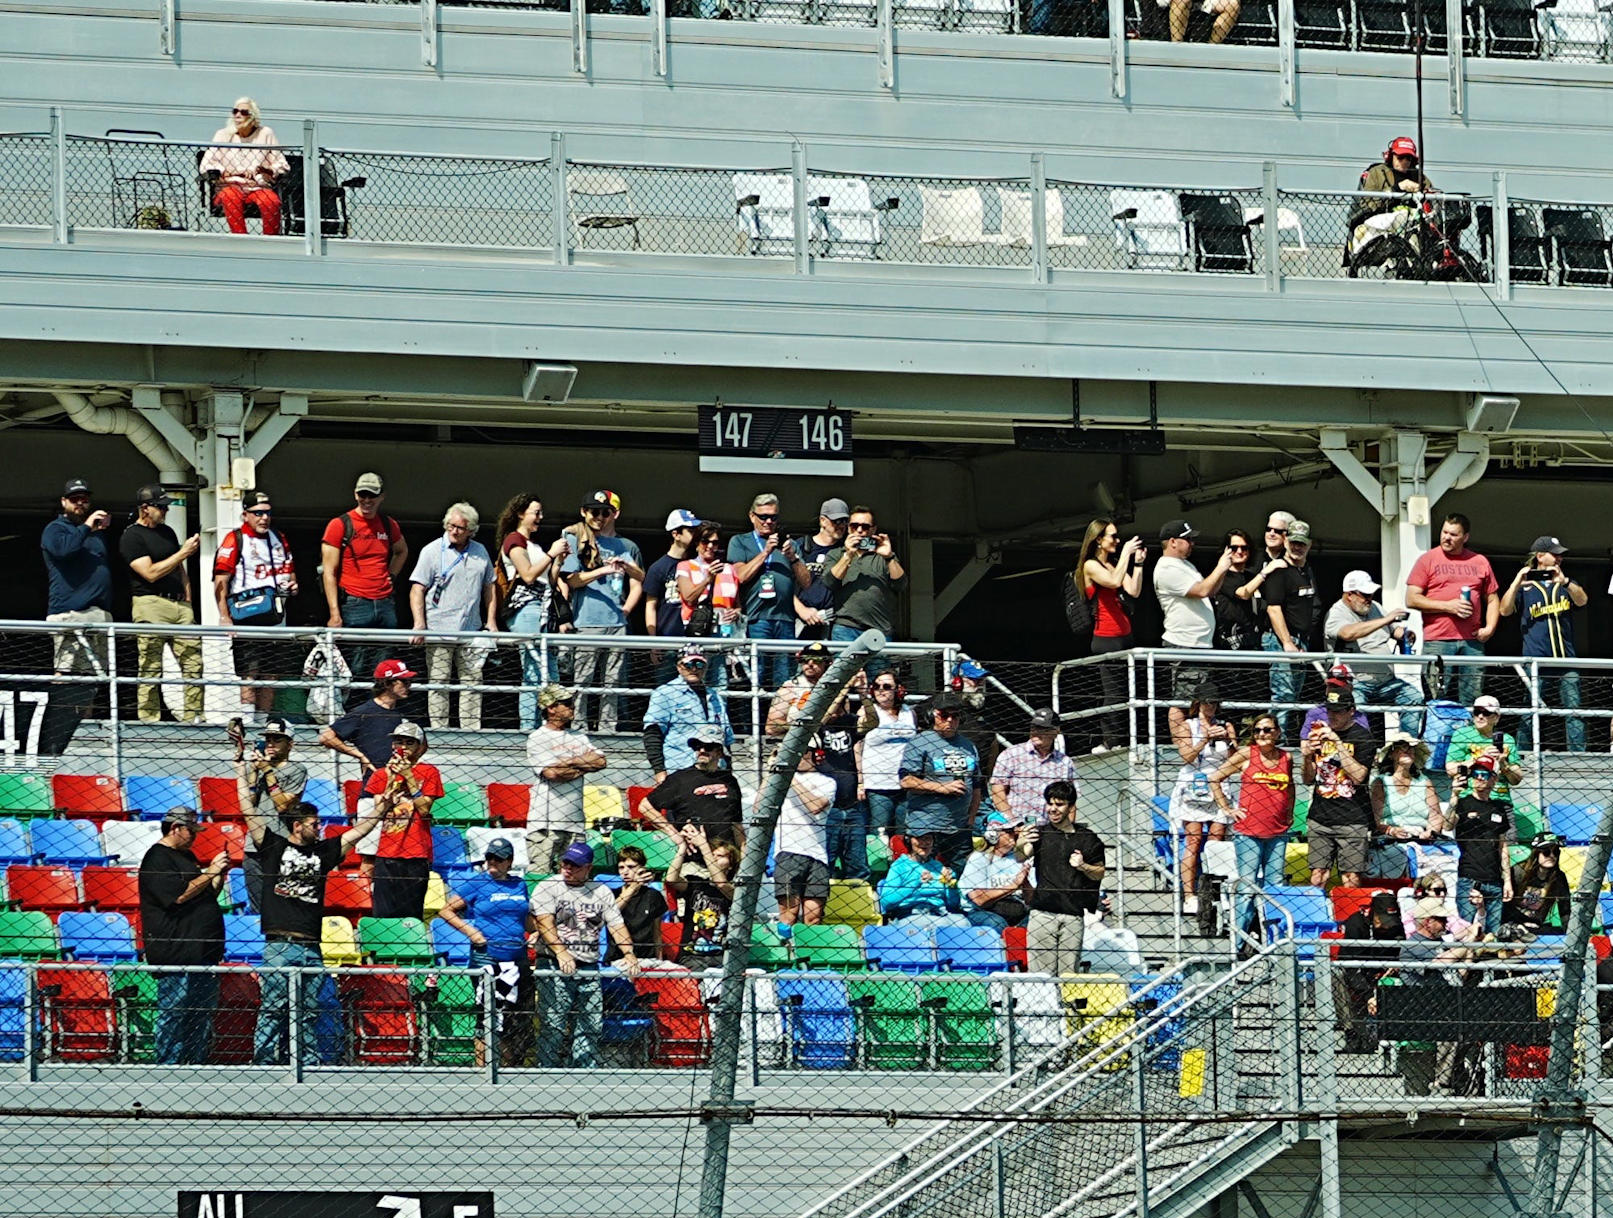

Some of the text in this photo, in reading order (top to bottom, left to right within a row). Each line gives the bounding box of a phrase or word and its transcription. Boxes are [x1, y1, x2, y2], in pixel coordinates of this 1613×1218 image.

[712, 413, 843, 451] 147 146
[1435, 563, 1479, 578] BOSTON
